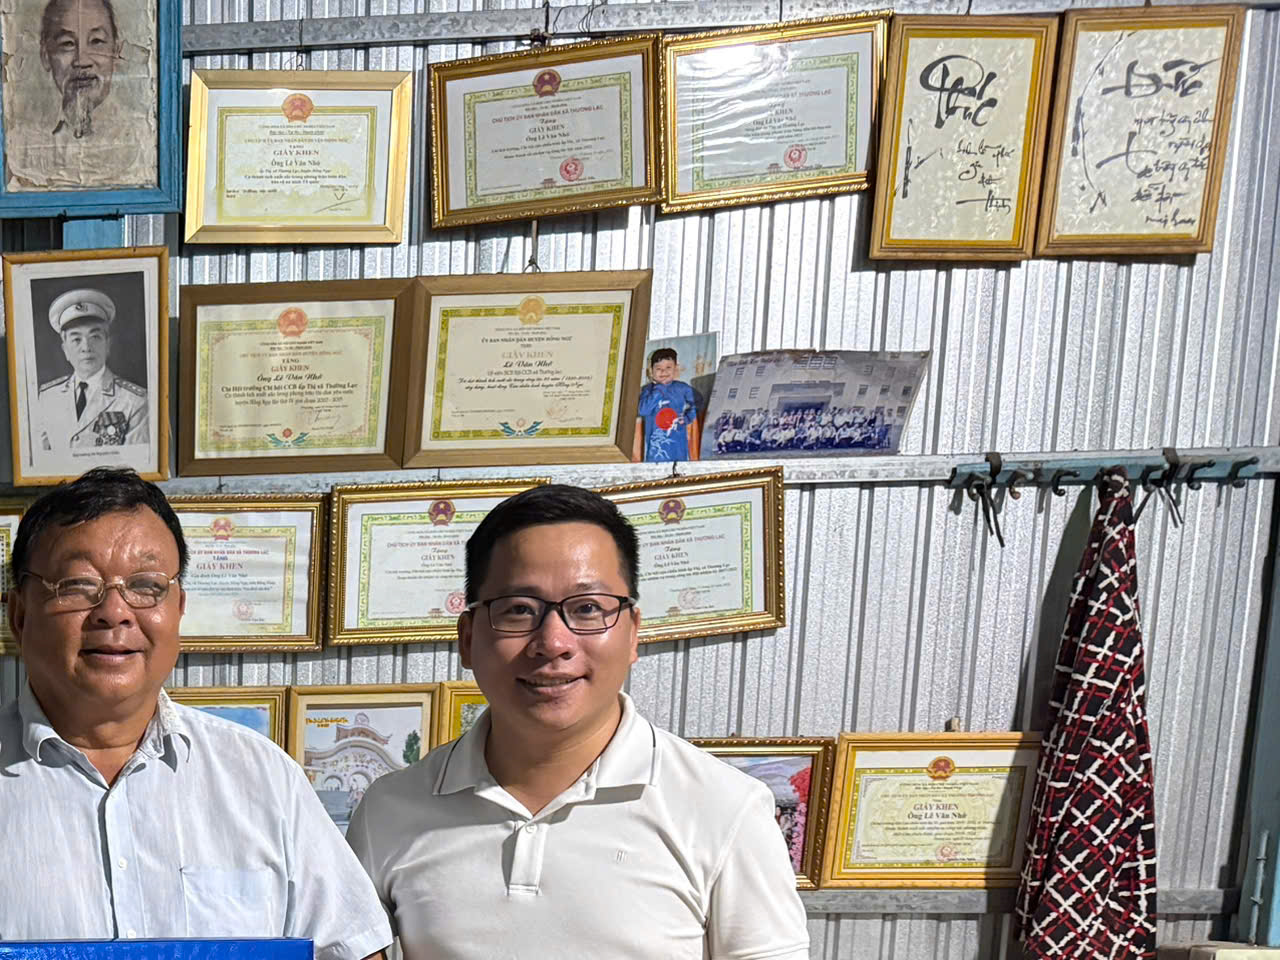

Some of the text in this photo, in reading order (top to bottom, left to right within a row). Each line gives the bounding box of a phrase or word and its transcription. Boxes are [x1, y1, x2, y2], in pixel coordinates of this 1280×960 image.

[546, 124, 565, 132] KHEN
[526, 351, 553, 359] KHEN
[654, 551, 689, 561] GIẤY KHEN
[196, 562, 216, 570] GIẤY
[913, 802, 959, 811] GIẤY KHEN
[907, 811, 923, 820] Ông
